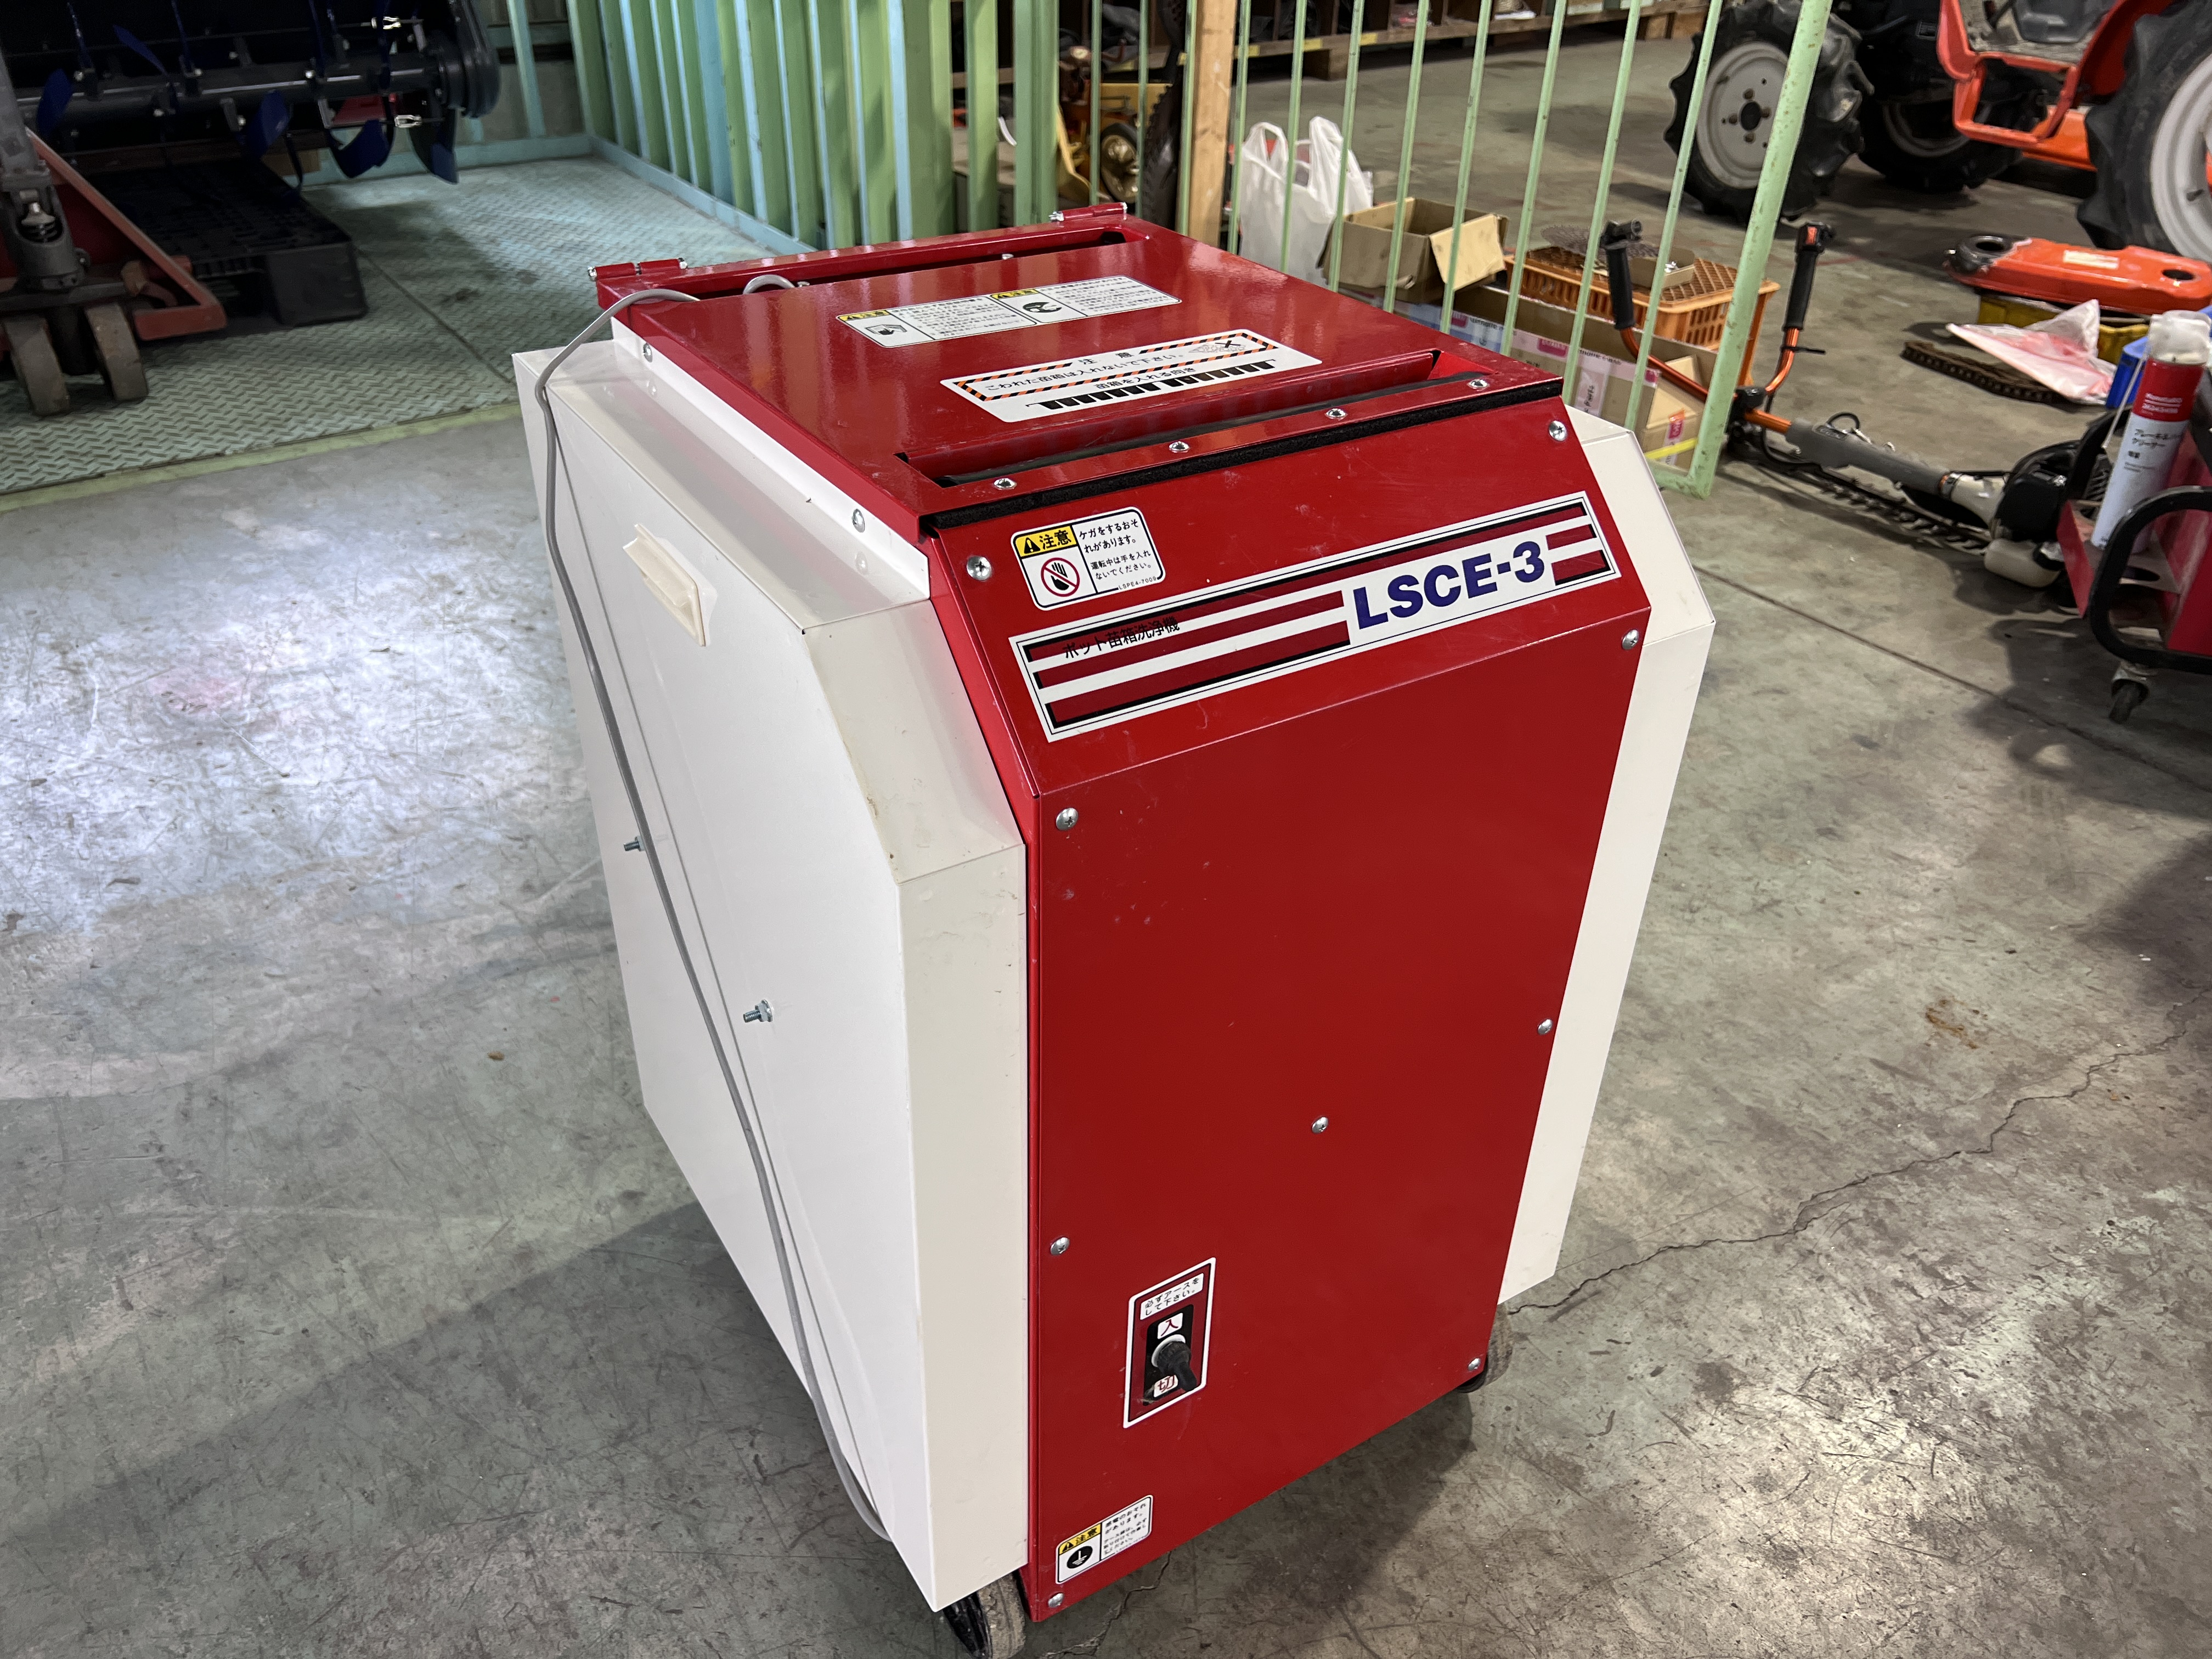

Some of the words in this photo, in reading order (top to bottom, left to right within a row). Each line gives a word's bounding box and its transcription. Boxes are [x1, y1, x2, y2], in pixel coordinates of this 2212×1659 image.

[1078, 352, 1135, 365] 注意
[1040, 529, 1071, 550] 注意
[1079, 518, 1139, 540] ケガをするおそ
[1084, 535, 1136, 554] れがあります。
[1090, 550, 1151, 571] 運転中は手を入れ
[1095, 563, 1152, 580] ないでください。
[1353, 541, 1545, 629] LSCE-3
[1144, 1277, 1200, 1308] 必ずアースを
[1145, 1289, 1196, 1316] して下さい。
[1160, 1319, 1179, 1336] 入
[1158, 1374, 1176, 1392] 切
